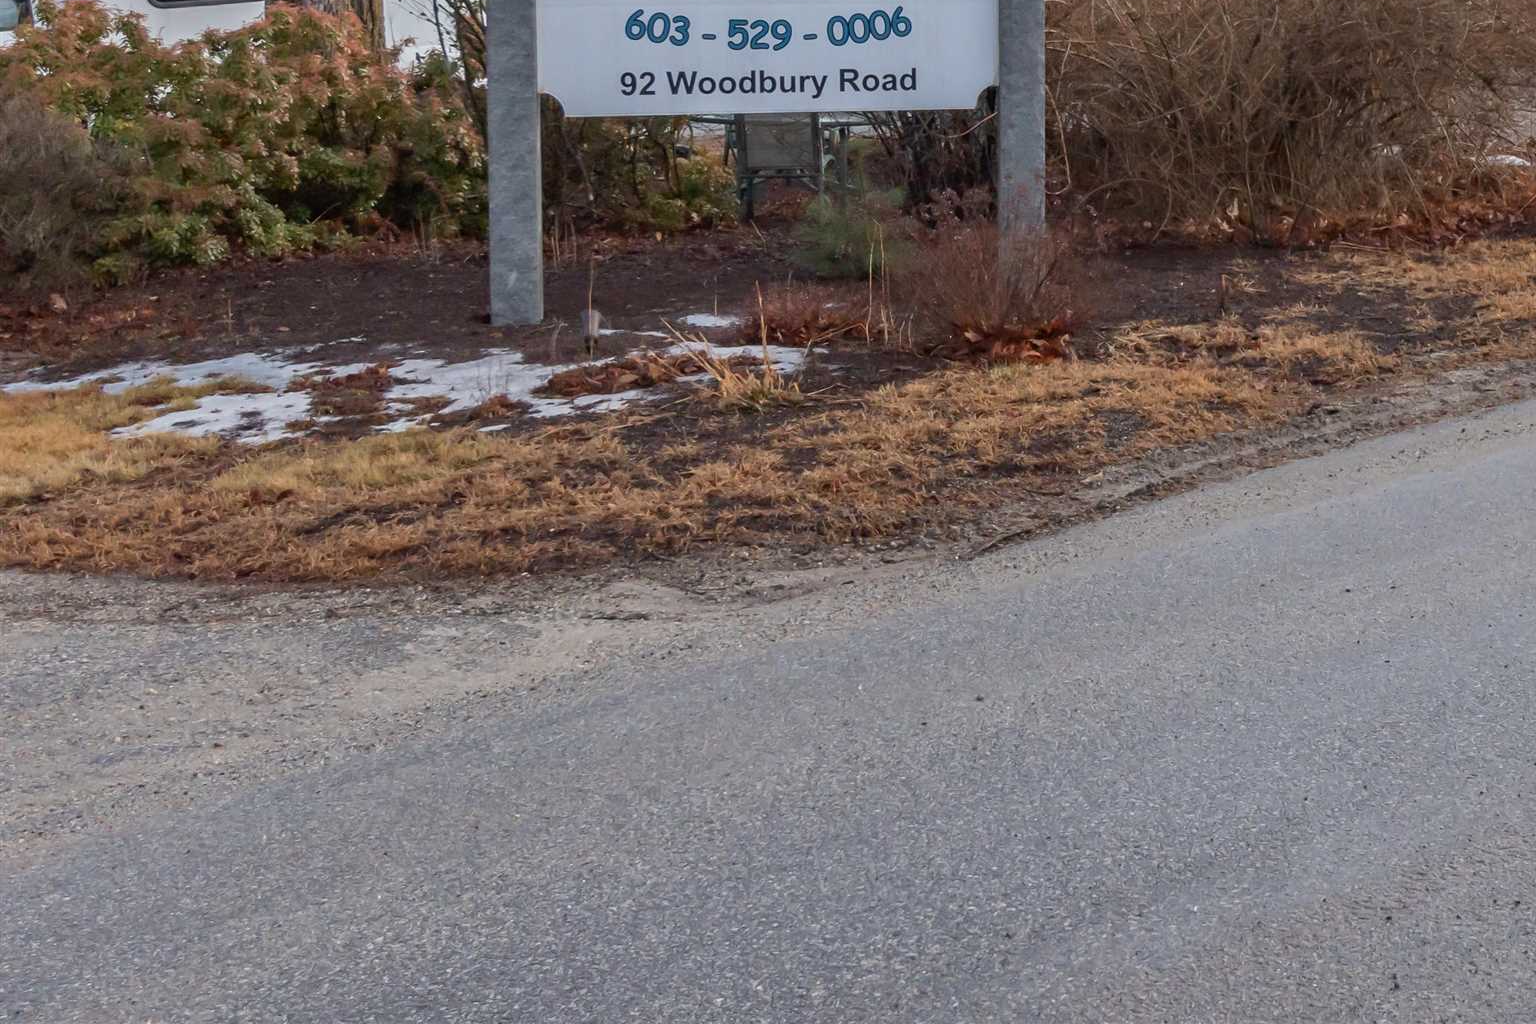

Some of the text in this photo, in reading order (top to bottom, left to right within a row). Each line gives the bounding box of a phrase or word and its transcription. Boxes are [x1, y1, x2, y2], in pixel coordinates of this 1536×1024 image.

[620, 67, 918, 100] 92 Woodbury Road
